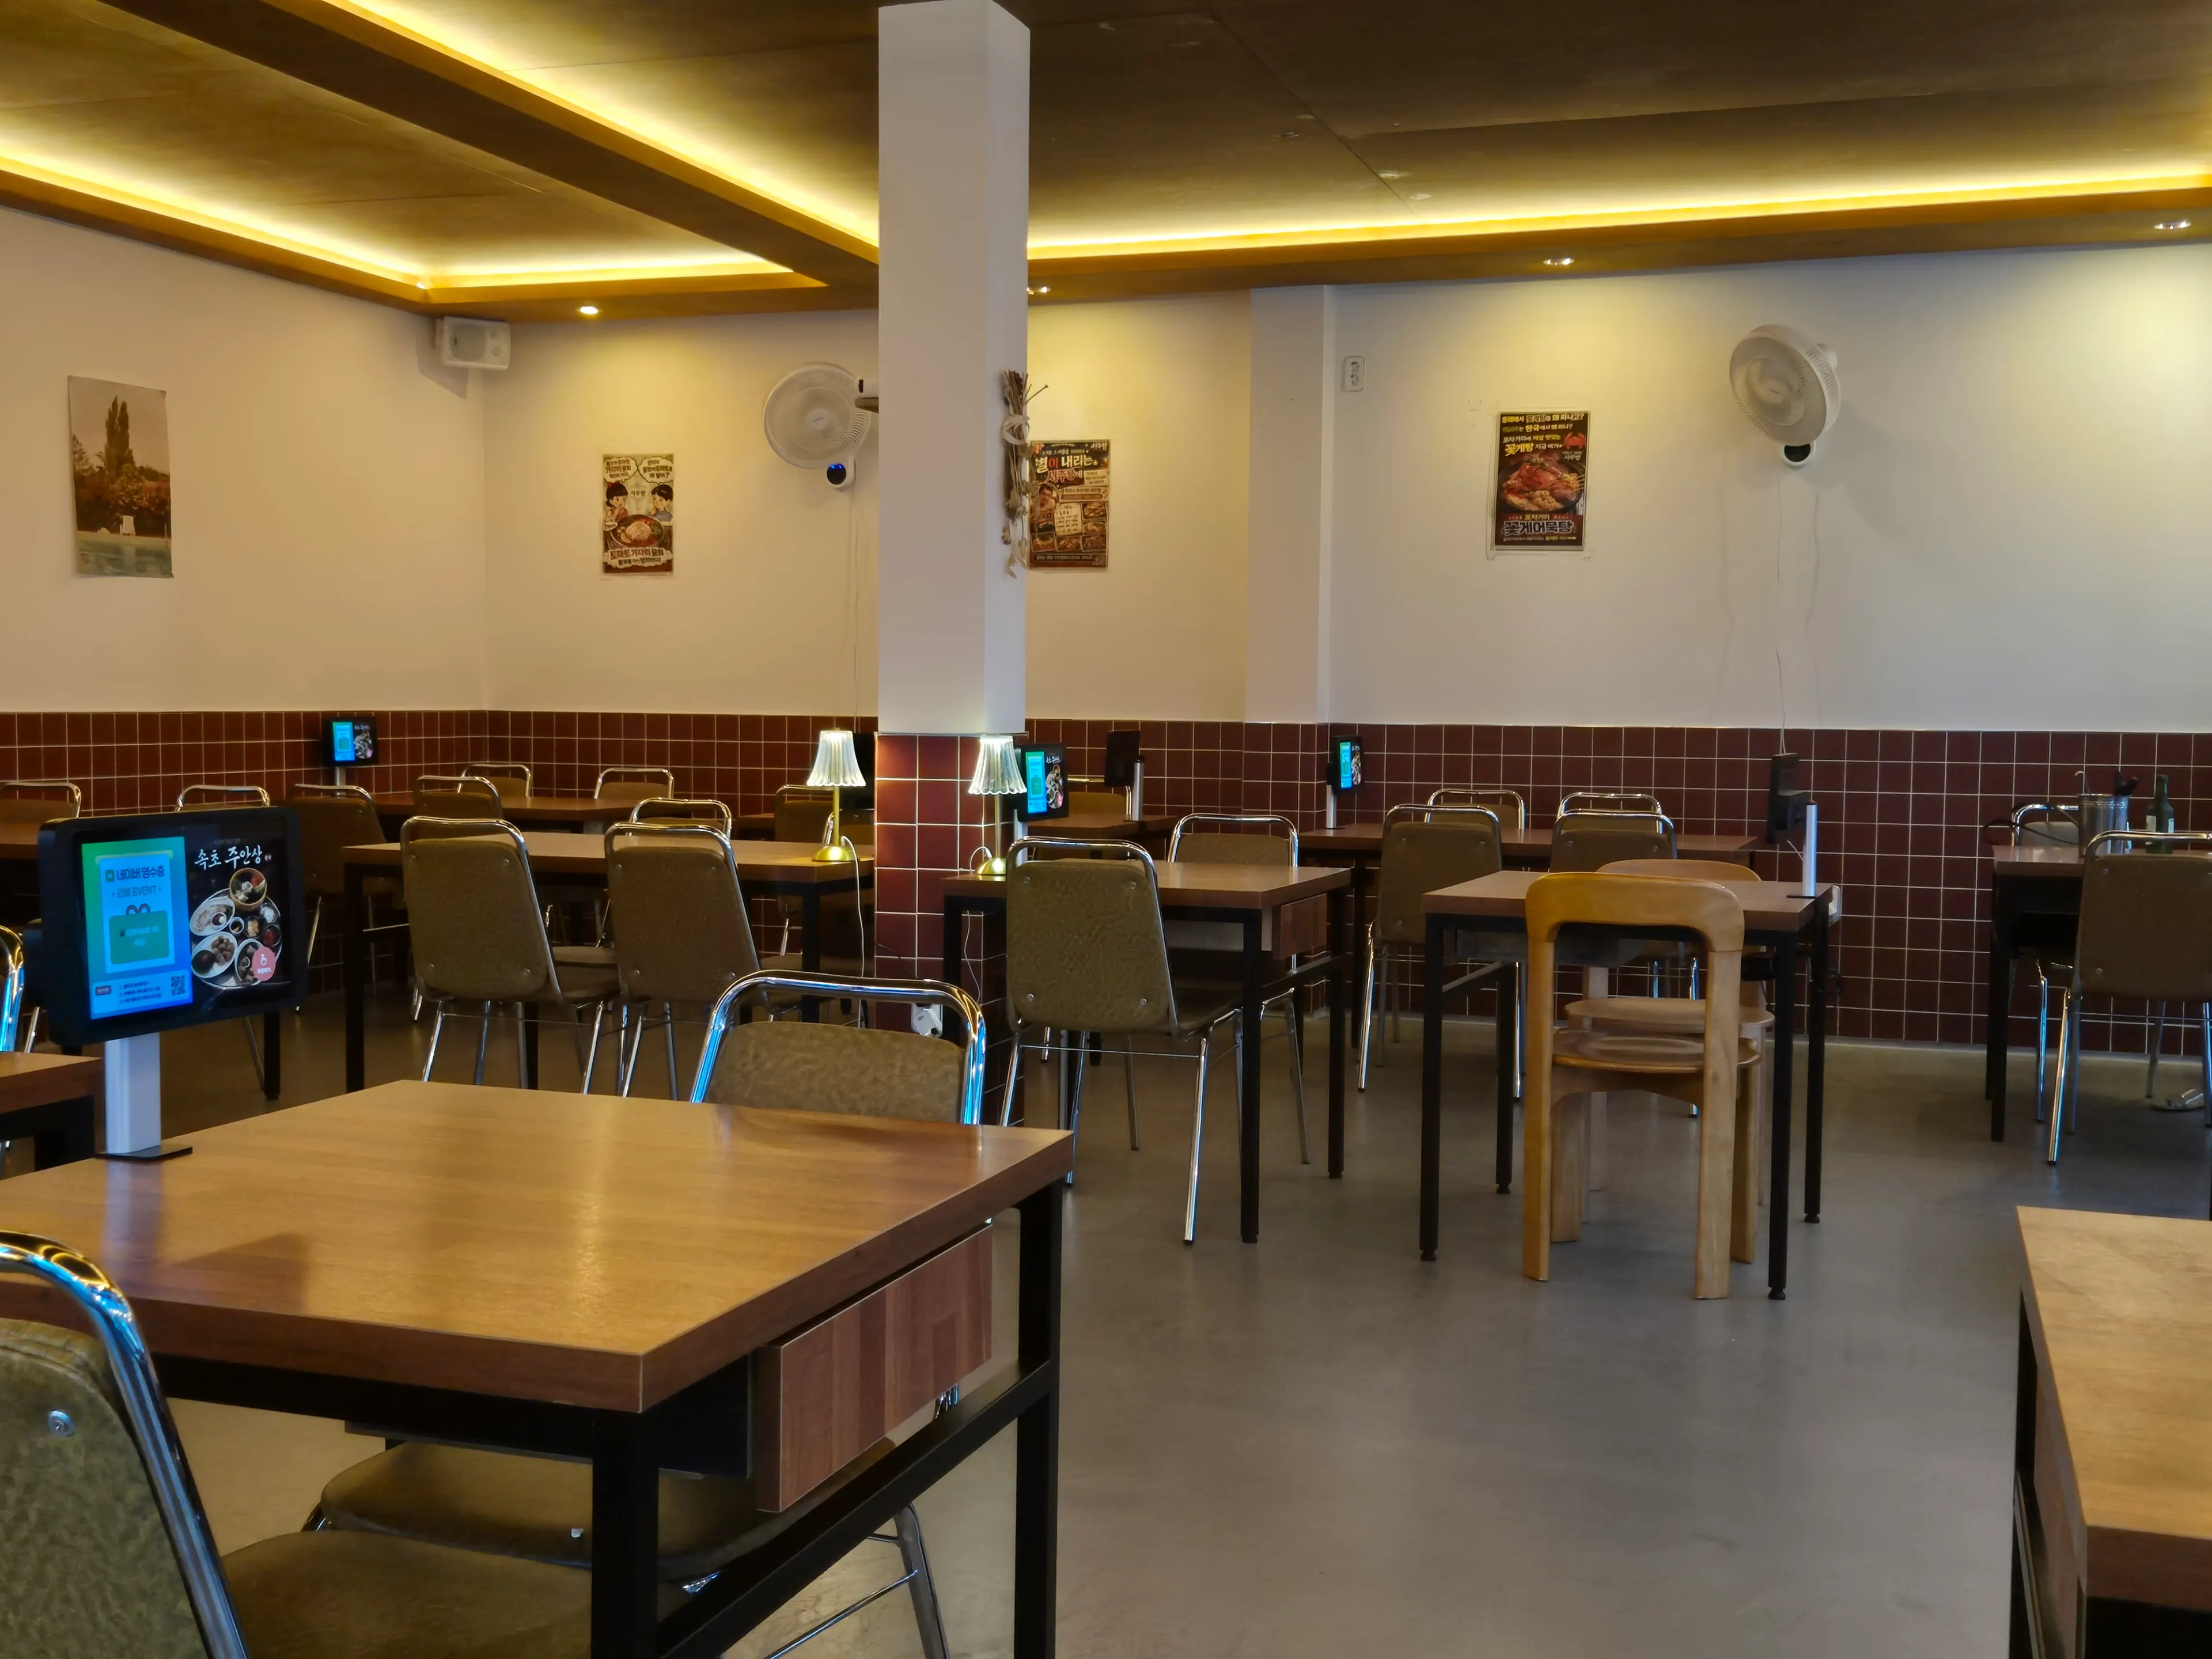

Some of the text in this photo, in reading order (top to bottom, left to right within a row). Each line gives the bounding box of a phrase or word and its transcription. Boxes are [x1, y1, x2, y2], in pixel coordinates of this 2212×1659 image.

[1035, 454, 1093, 474] 별이 내리는
[1503, 520, 1574, 536] 꽃게어묵탕
[194, 844, 263, 870] 속초 주안상
[116, 868, 141, 881] 네이버
[132, 885, 157, 896] EVENT
